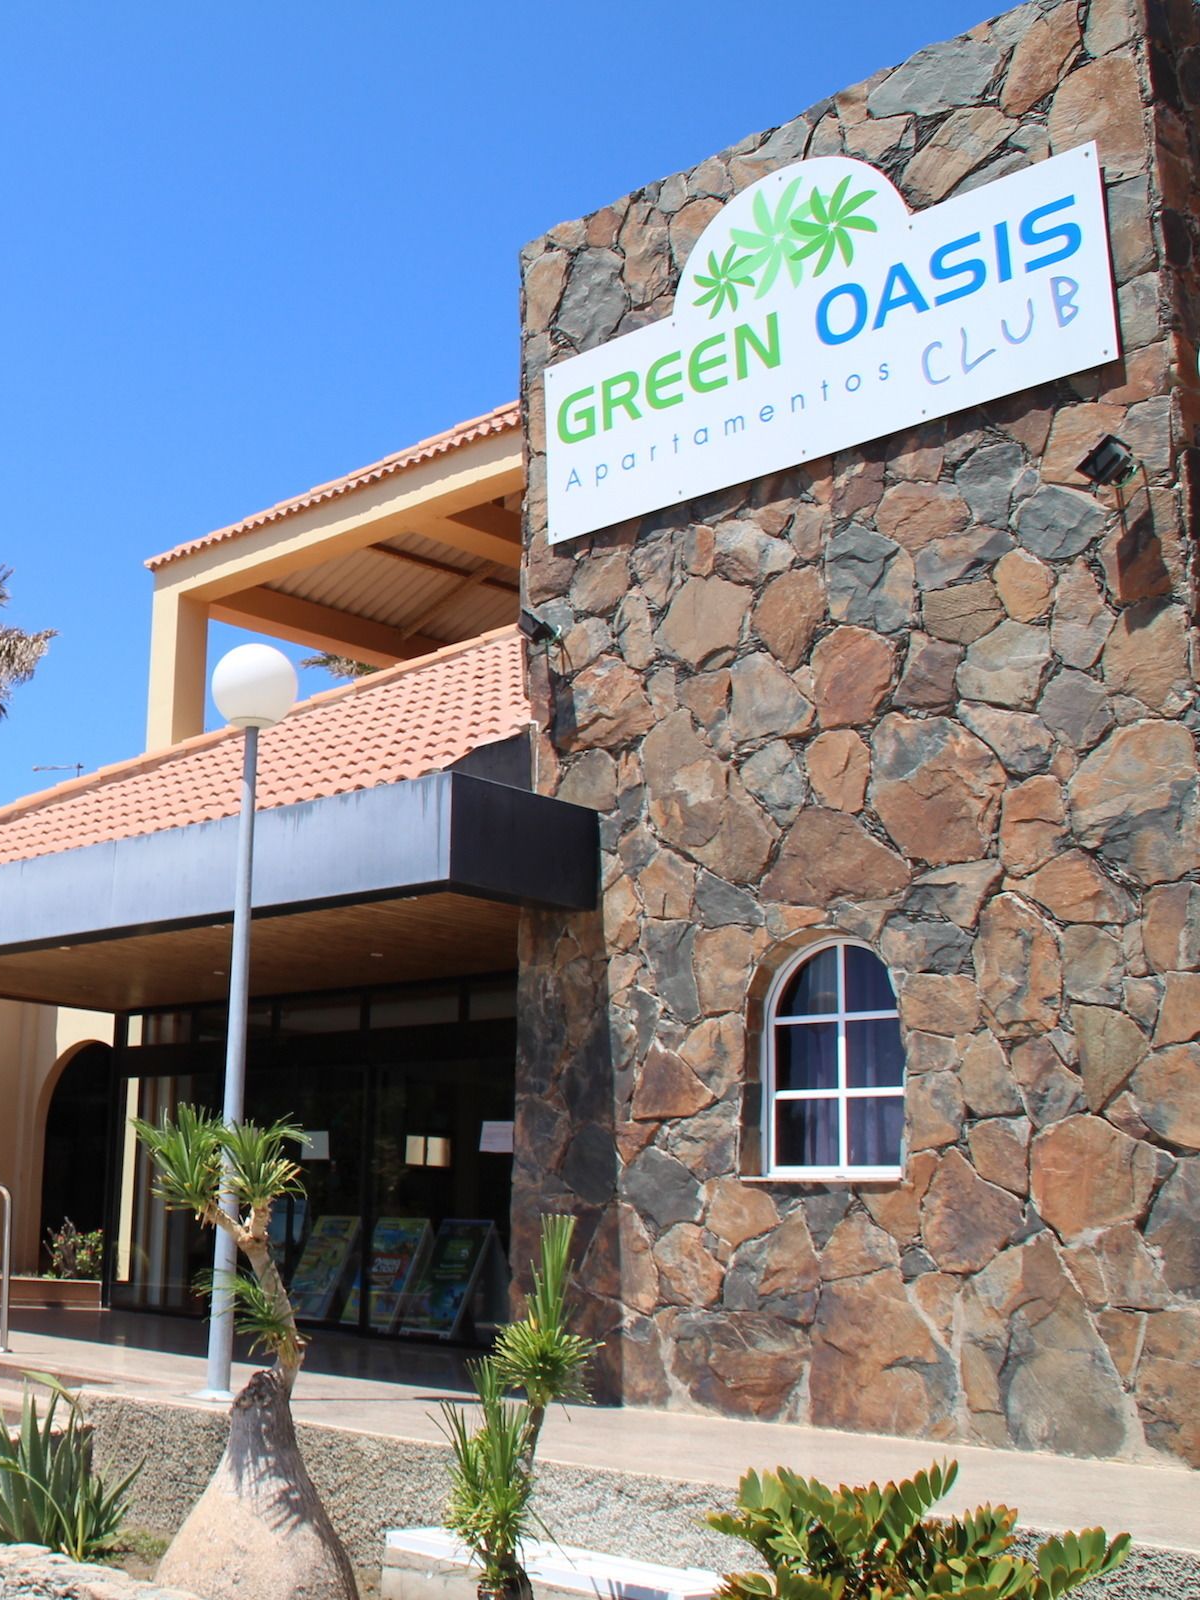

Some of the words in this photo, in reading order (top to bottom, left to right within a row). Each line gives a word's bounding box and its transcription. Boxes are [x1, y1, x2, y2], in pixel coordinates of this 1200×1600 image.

[557, 312, 783, 444] GREEN
[815, 193, 1083, 346] OASIS
[566, 362, 891, 490] Apartamentos
[922, 276, 1082, 385] CLUB
